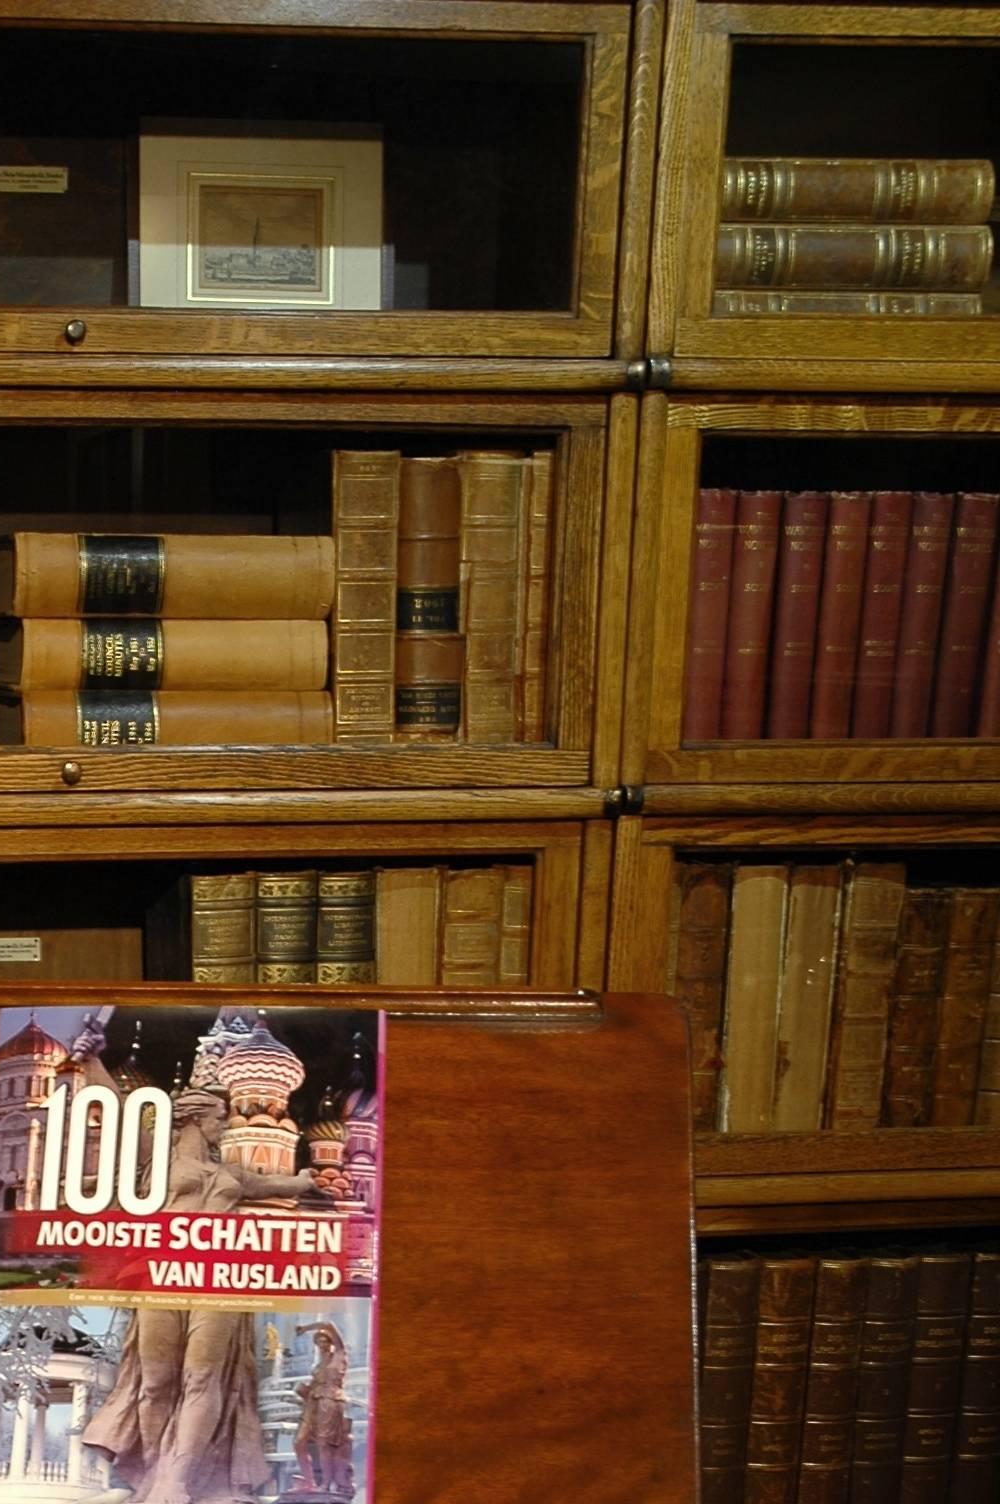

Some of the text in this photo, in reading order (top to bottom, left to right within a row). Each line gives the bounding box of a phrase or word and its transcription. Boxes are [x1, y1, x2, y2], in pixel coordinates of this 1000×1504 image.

[105, 634, 113, 677] COUNCIL
[114, 634, 124, 677] MINUTES
[37, 1084, 172, 1216] 100
[37, 1216, 342, 1253] MOOISTE SCHATTEN
[149, 1260, 342, 1290] VAN RUSLAND
